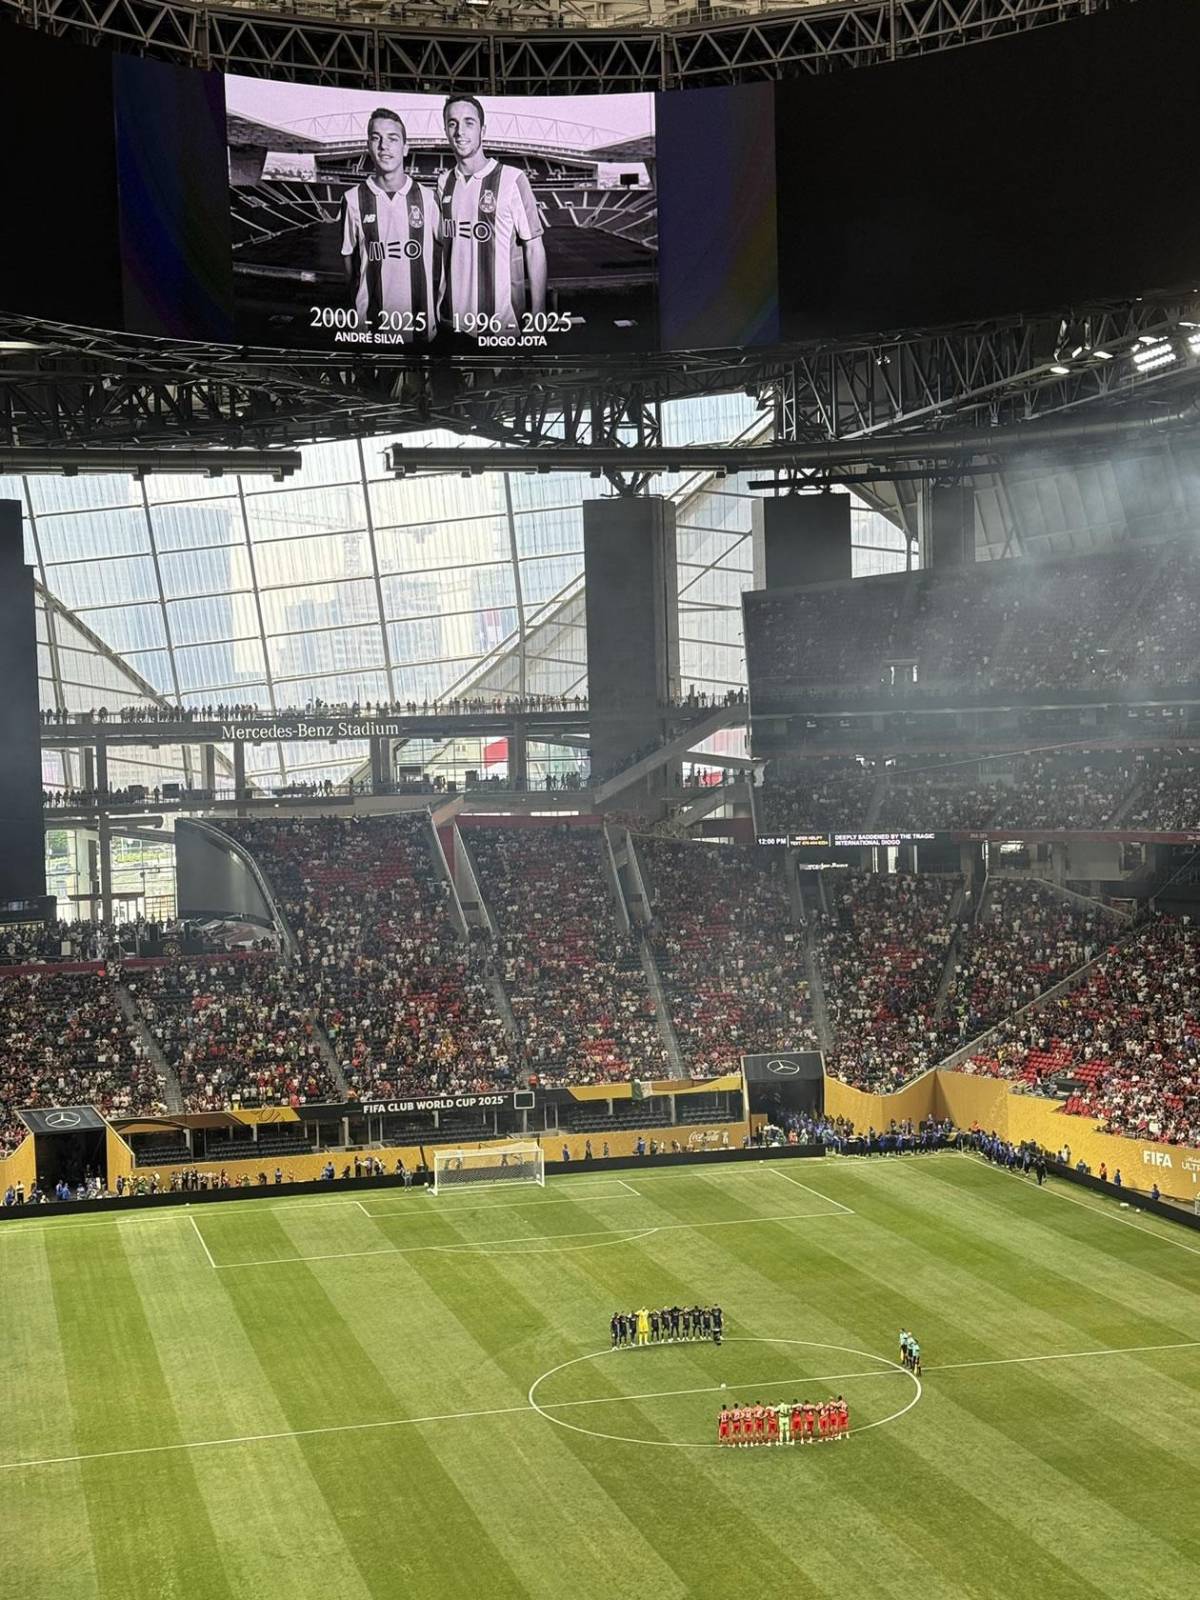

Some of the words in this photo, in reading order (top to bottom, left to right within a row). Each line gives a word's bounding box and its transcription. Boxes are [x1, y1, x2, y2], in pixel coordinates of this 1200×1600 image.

[368, 239, 421, 261] MEO
[310, 306, 359, 329] 2000
[378, 310, 427, 331] 2025
[453, 312, 502, 333] 1996
[521, 312, 572, 333] 2025
[334, 330, 373, 343] ANDRÉ
[374, 333, 404, 344] SILVA
[478, 336, 516, 346] DIOGO
[517, 336, 548, 346] JOTA
[221, 723, 334, 739] Mercedes-Benz
[338, 722, 399, 736] Stadium
[363, 1103, 386, 1114] FIFA
[387, 1101, 415, 1112] CLUB
[416, 1099, 454, 1110] WORLD
[455, 1098, 476, 1107] CUP
[1143, 1150, 1173, 1169] FIFA
